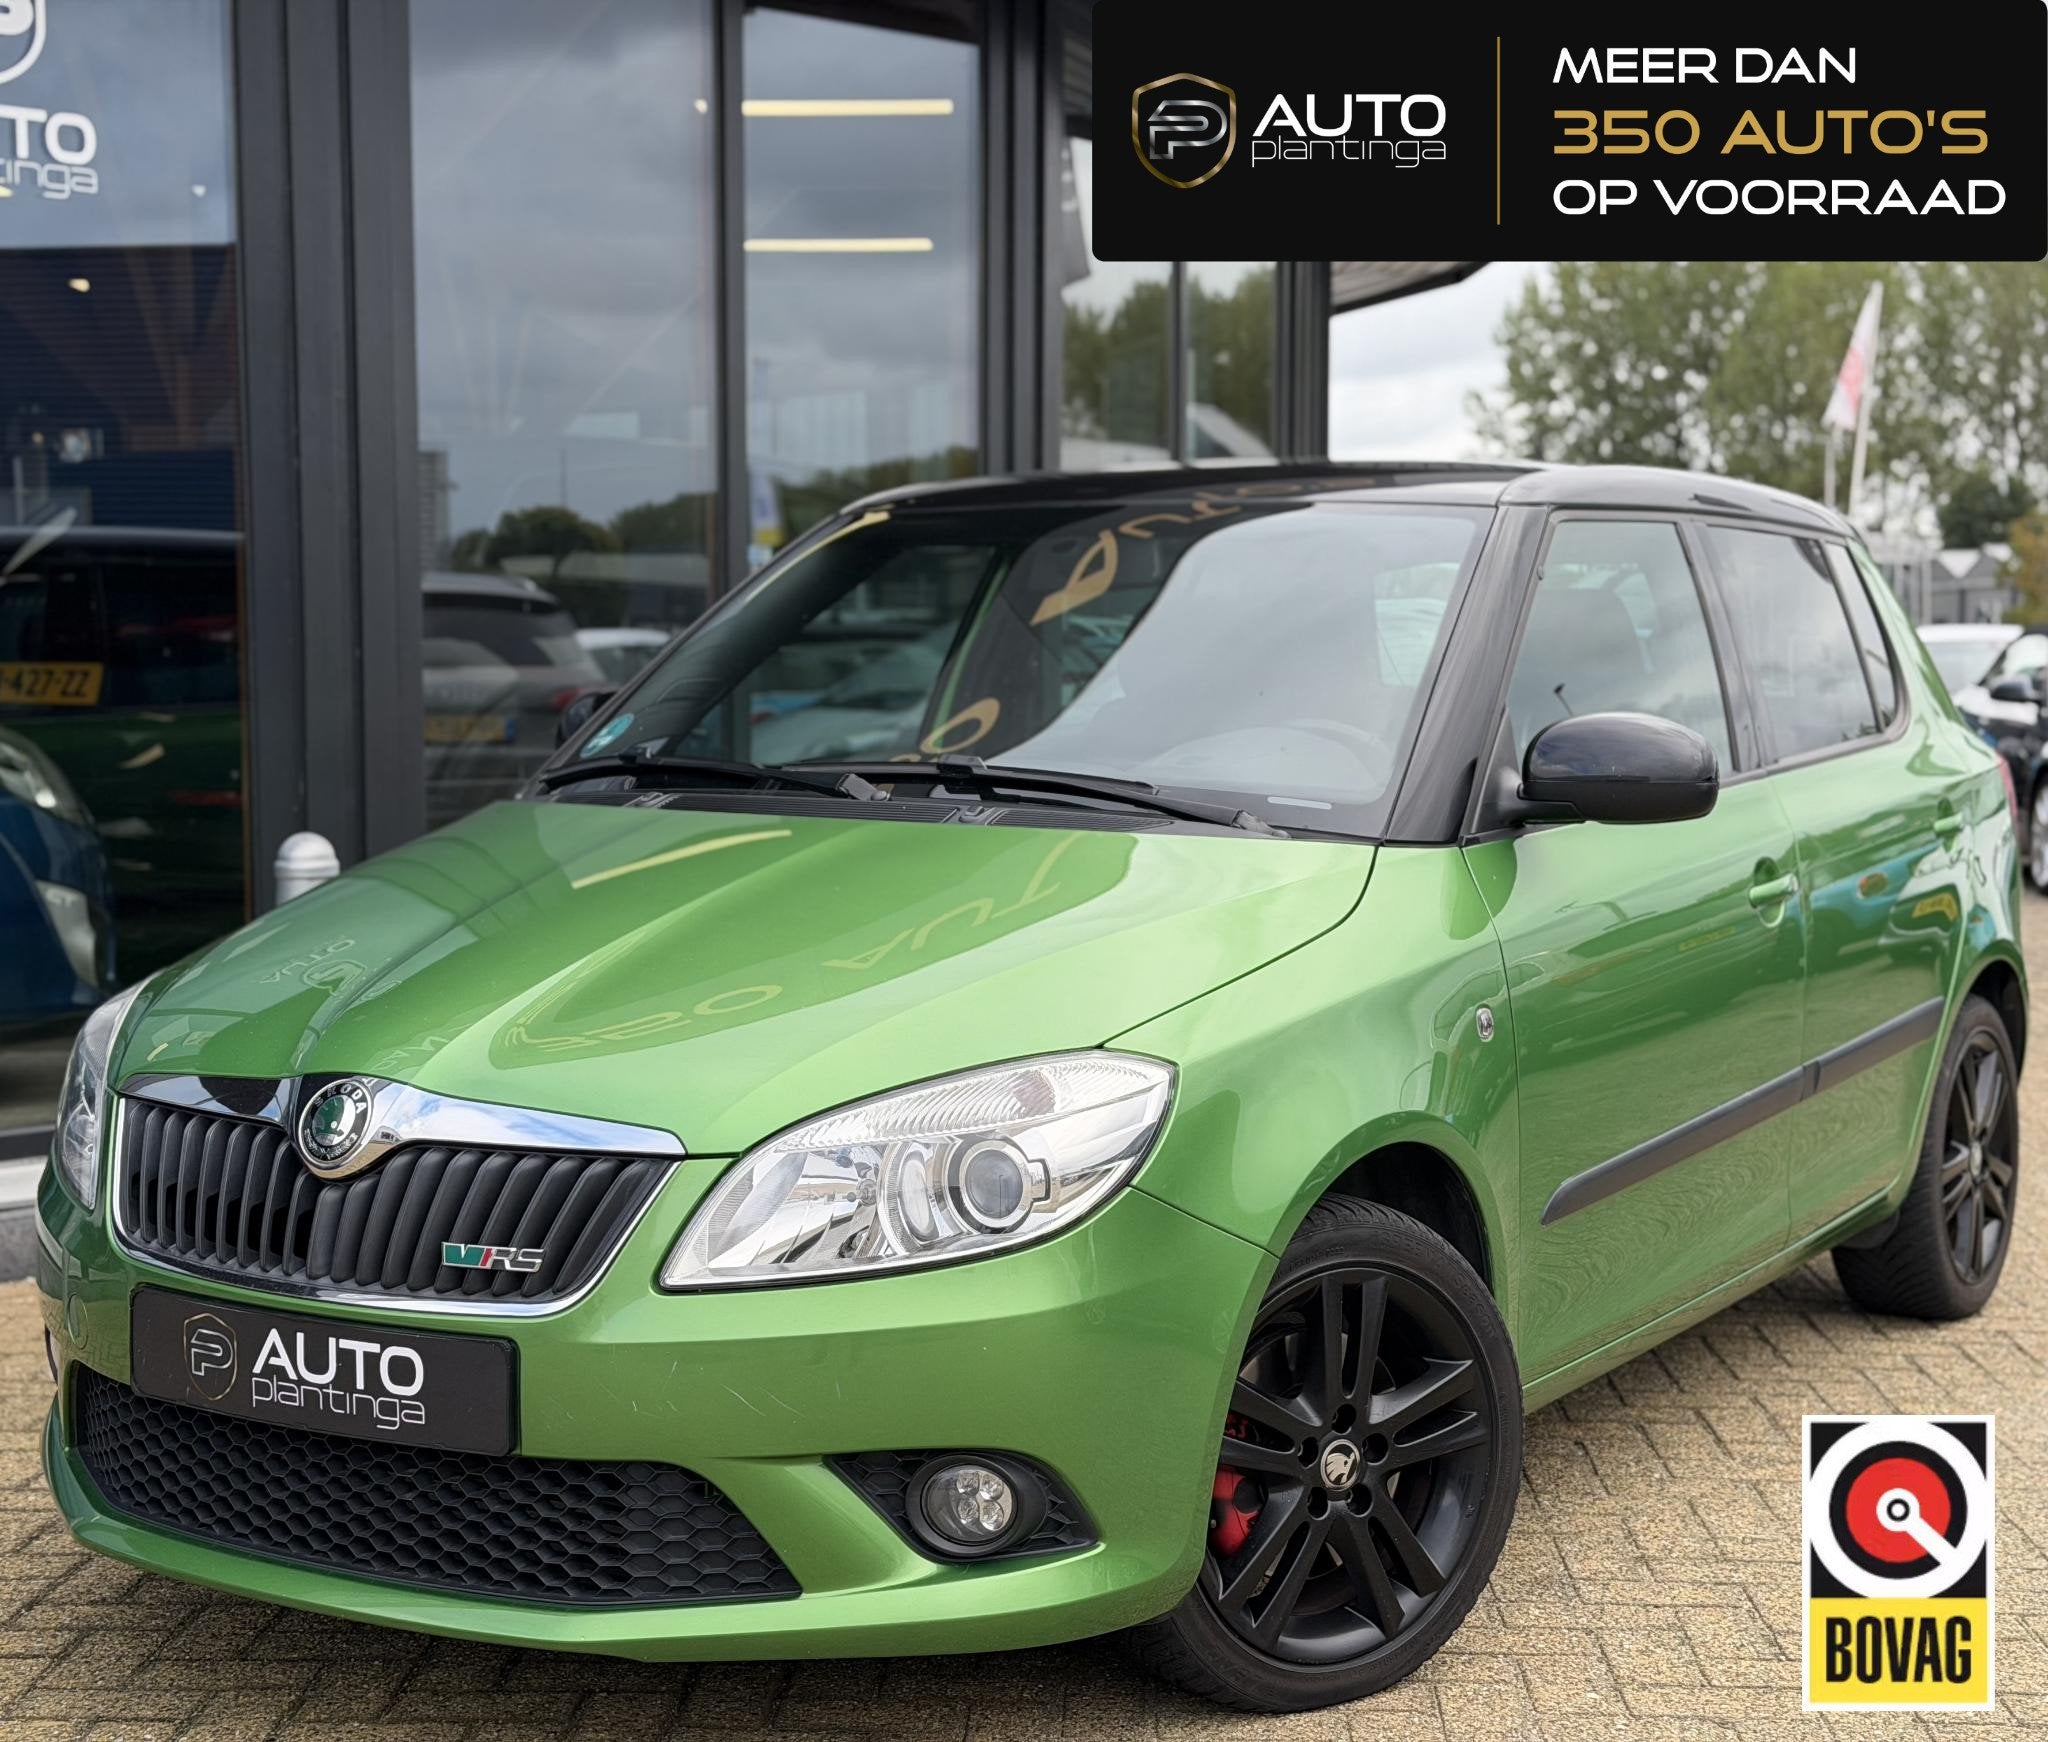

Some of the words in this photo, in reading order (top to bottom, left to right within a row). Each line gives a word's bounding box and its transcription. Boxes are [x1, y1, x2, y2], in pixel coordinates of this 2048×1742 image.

[0, 158, 99, 200] inga
[0, 668, 91, 697] -427-ZZ
[251, 1327, 425, 1397] AUTO
[251, 1374, 426, 1431] plantinga
